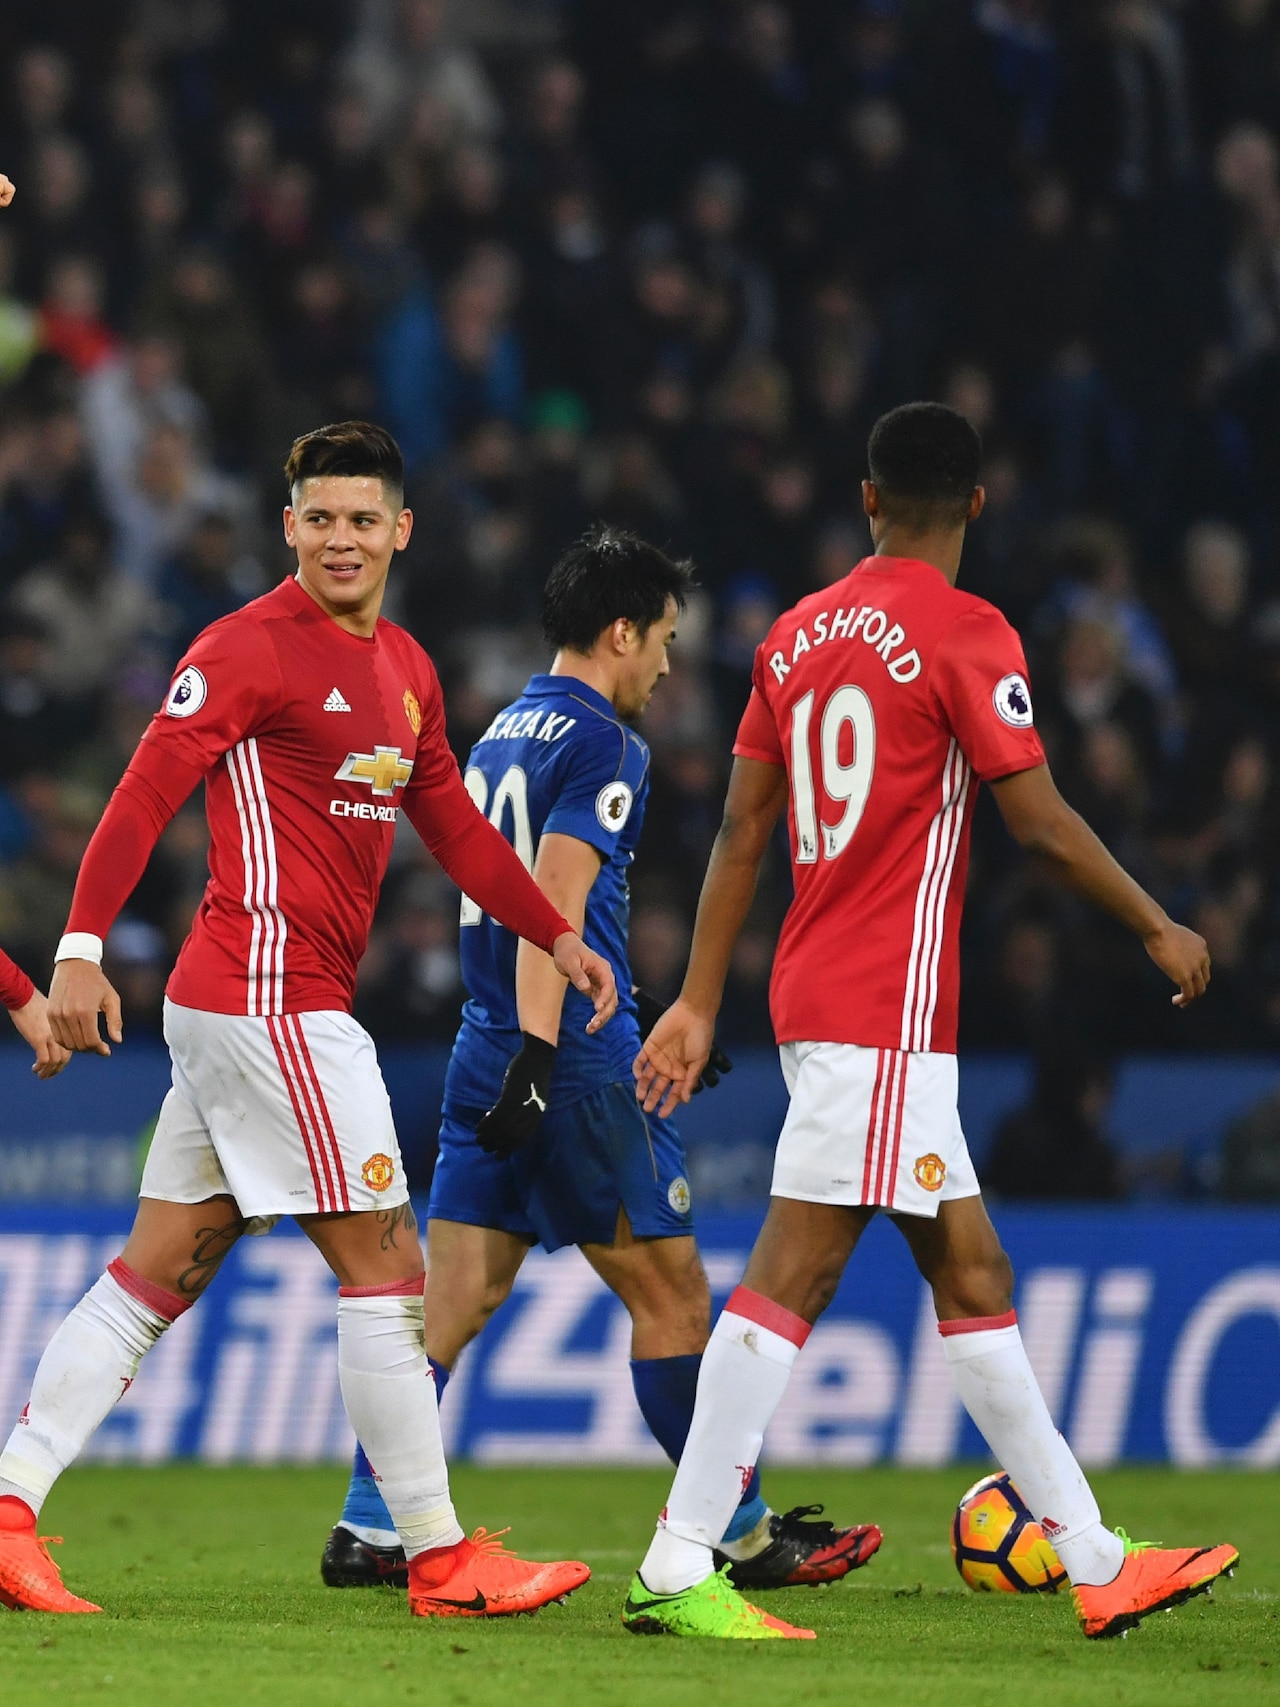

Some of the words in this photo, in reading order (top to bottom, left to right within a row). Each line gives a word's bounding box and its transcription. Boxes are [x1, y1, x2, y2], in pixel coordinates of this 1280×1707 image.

[769, 606, 922, 685] RASHFORD
[323, 702, 352, 713] adidas
[791, 684, 876, 864] 19
